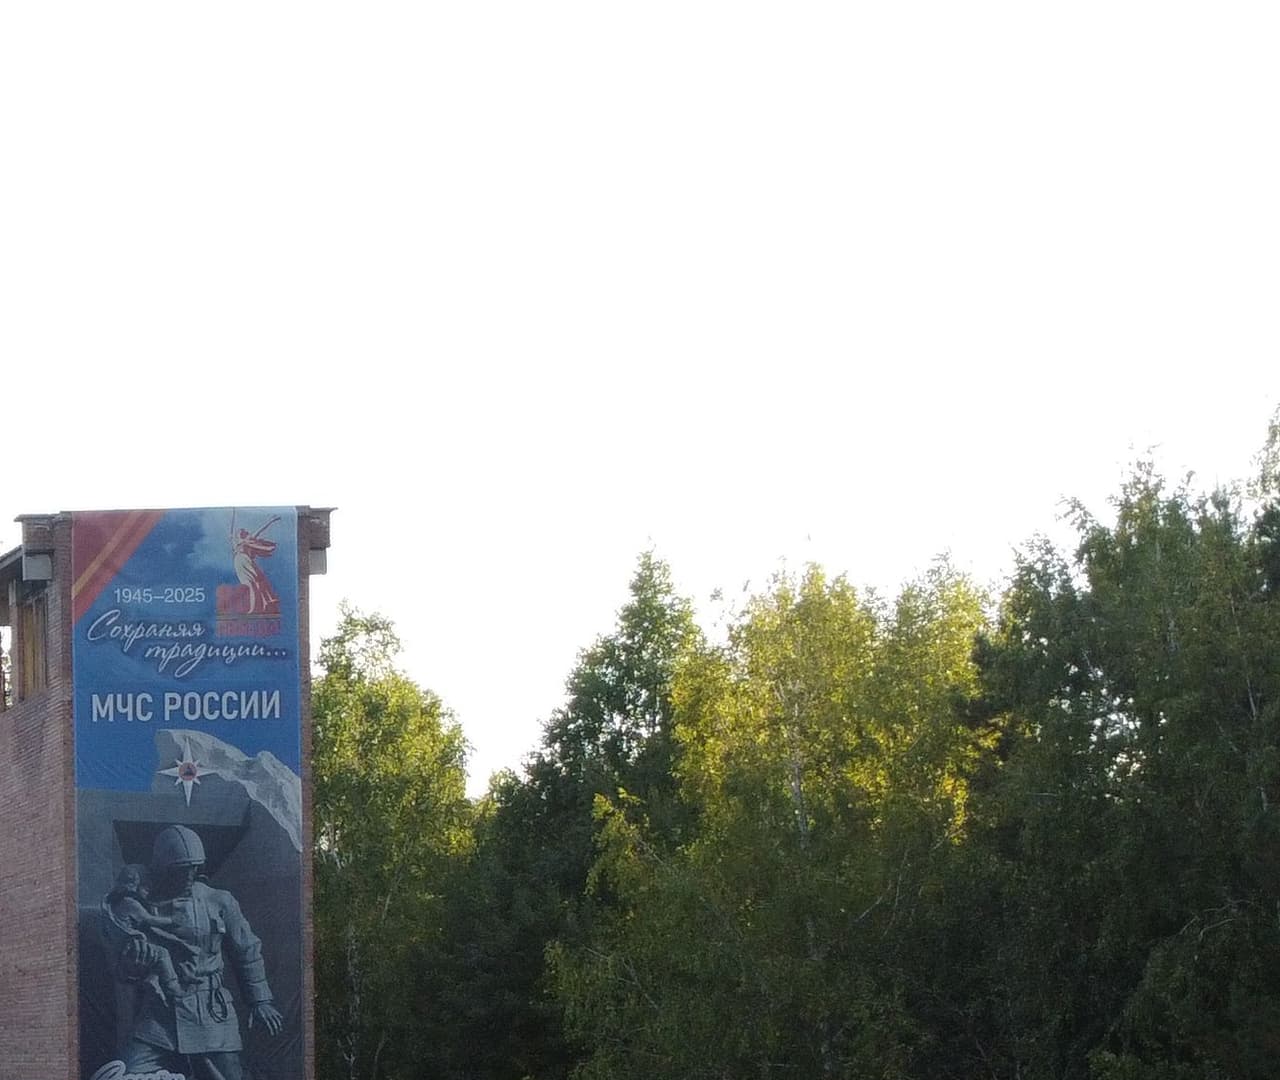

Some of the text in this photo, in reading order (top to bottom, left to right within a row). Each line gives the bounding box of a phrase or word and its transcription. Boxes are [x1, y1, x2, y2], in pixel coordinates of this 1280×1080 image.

[87, 609, 206, 653] Сохраняя
[91, 689, 282, 723] МЧС РОССИИ
